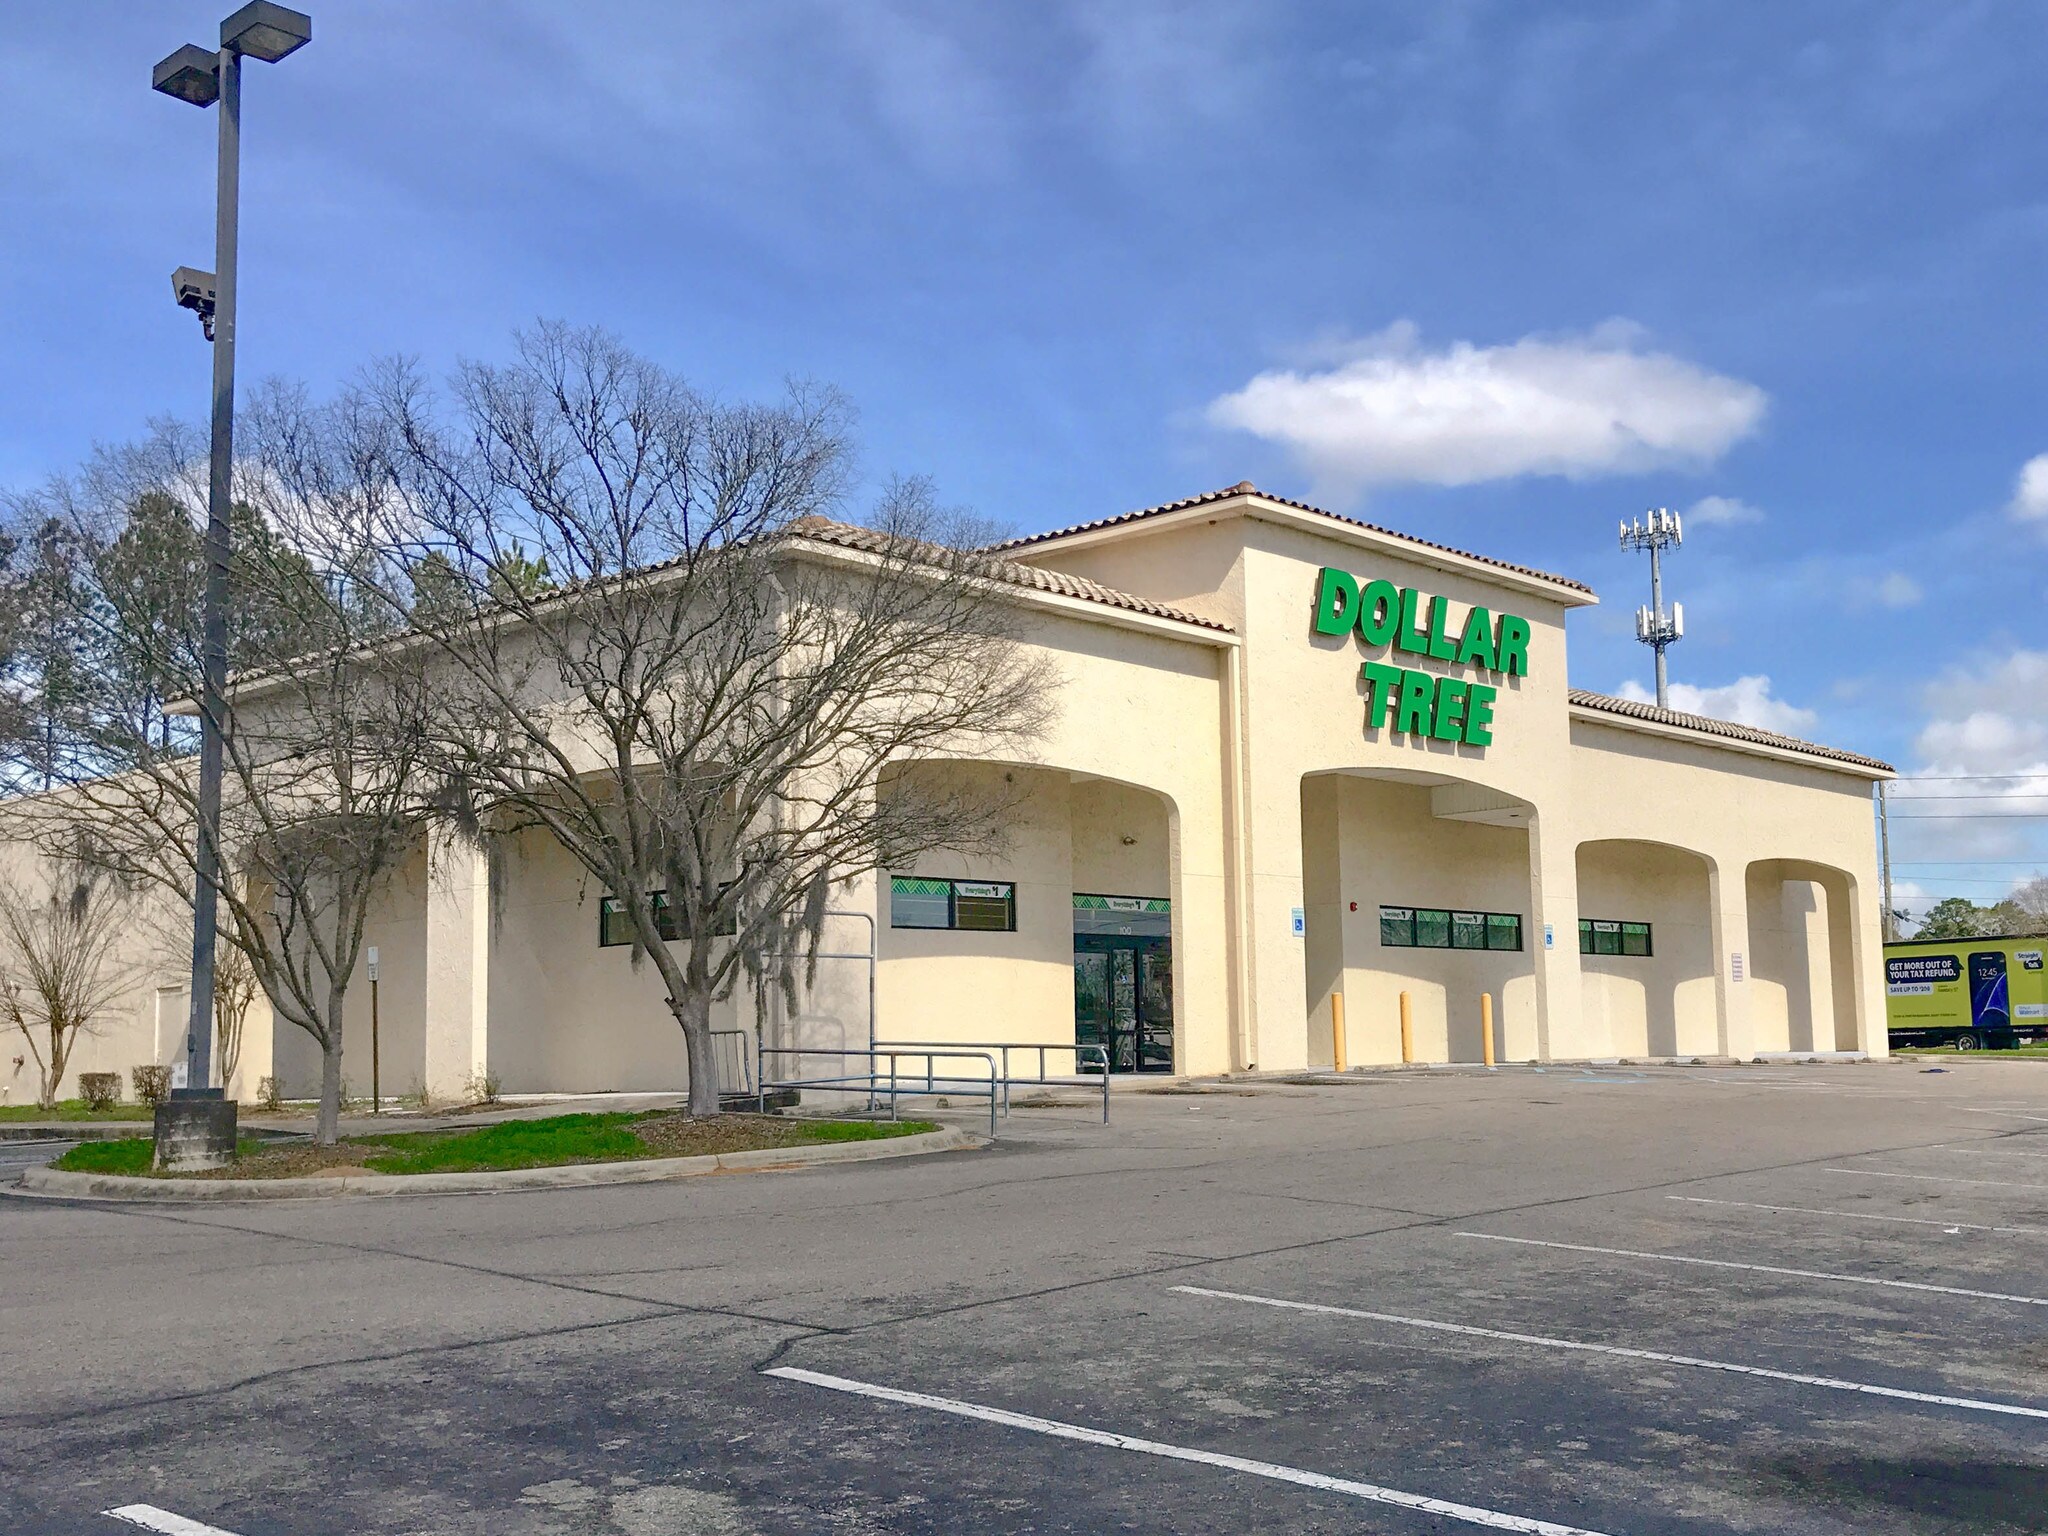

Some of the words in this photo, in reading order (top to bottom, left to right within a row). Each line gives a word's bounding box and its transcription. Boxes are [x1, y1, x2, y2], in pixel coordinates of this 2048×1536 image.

[1316, 566, 1531, 677] DOLLAR
[1360, 661, 1497, 746] TREE
[1889, 962, 1903, 971] GET
[1903, 961, 1925, 970] MORE
[1925, 960, 1941, 969] OUT
[1941, 960, 1952, 968] OF
[1889, 970, 1910, 979] YOUR
[1910, 969, 1925, 978] TAX
[1925, 968, 1957, 978] REFUND.
